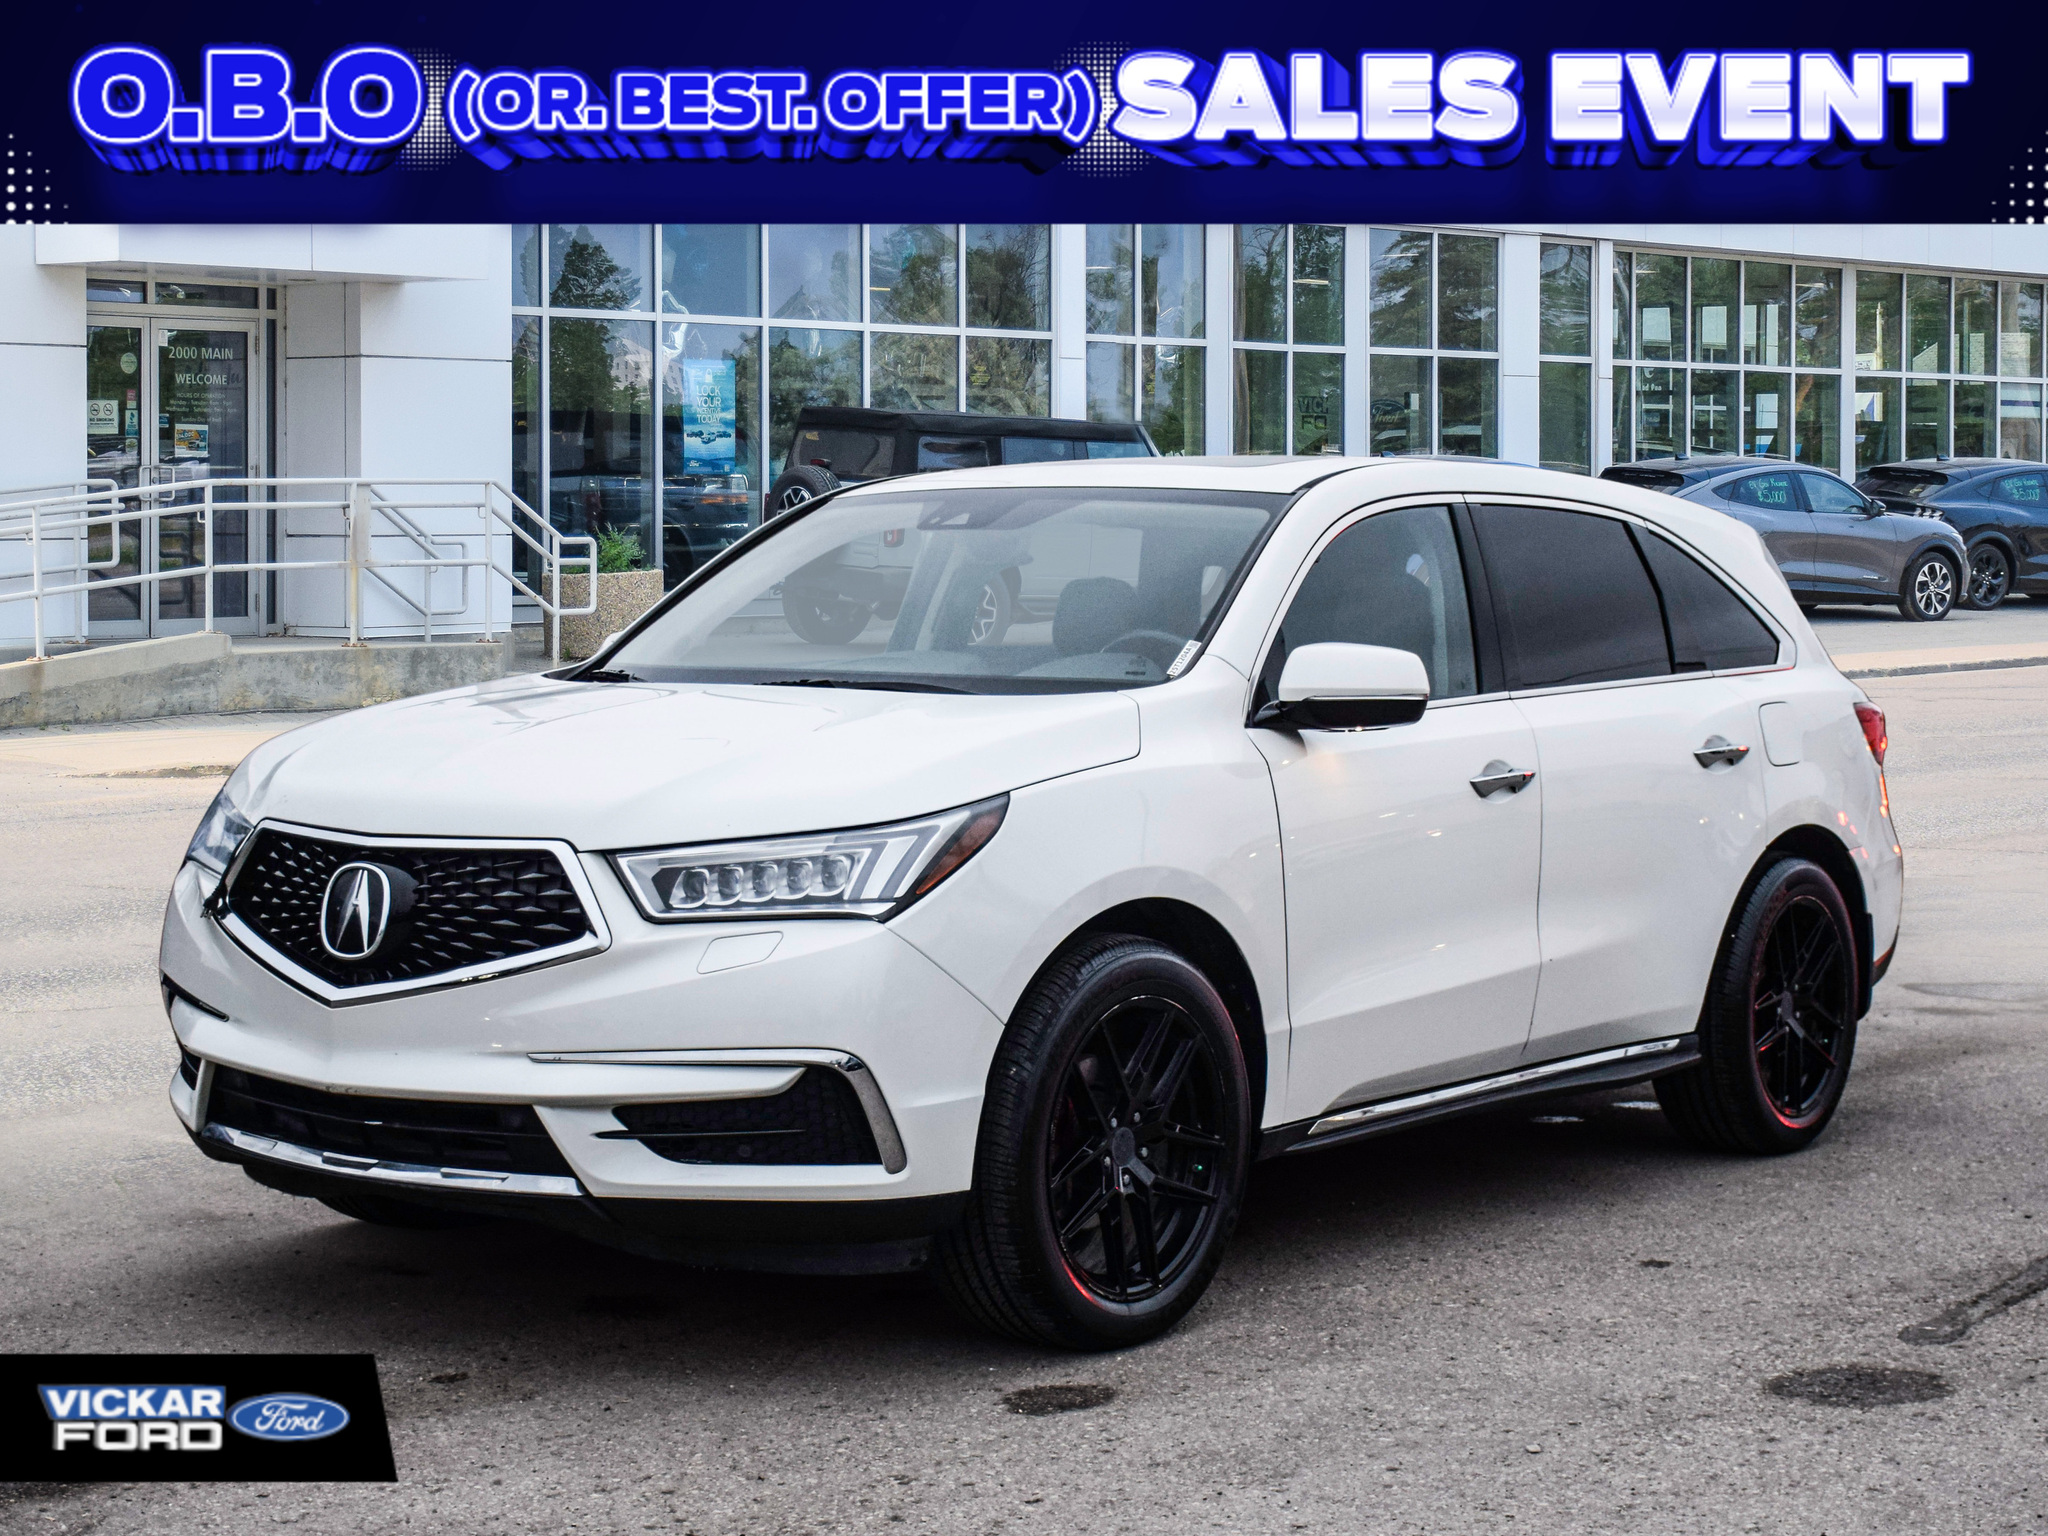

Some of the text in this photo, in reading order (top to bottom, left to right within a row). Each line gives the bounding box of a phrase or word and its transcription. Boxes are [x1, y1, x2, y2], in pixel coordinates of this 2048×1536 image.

[168, 346, 234, 360] 2000 MAIN
[175, 373, 228, 385] WELCOME
[696, 385, 721, 396] LOCK
[696, 396, 722, 407] YOUR
[696, 414, 721, 424] TODAY
[1757, 489, 1787, 504] $5,000
